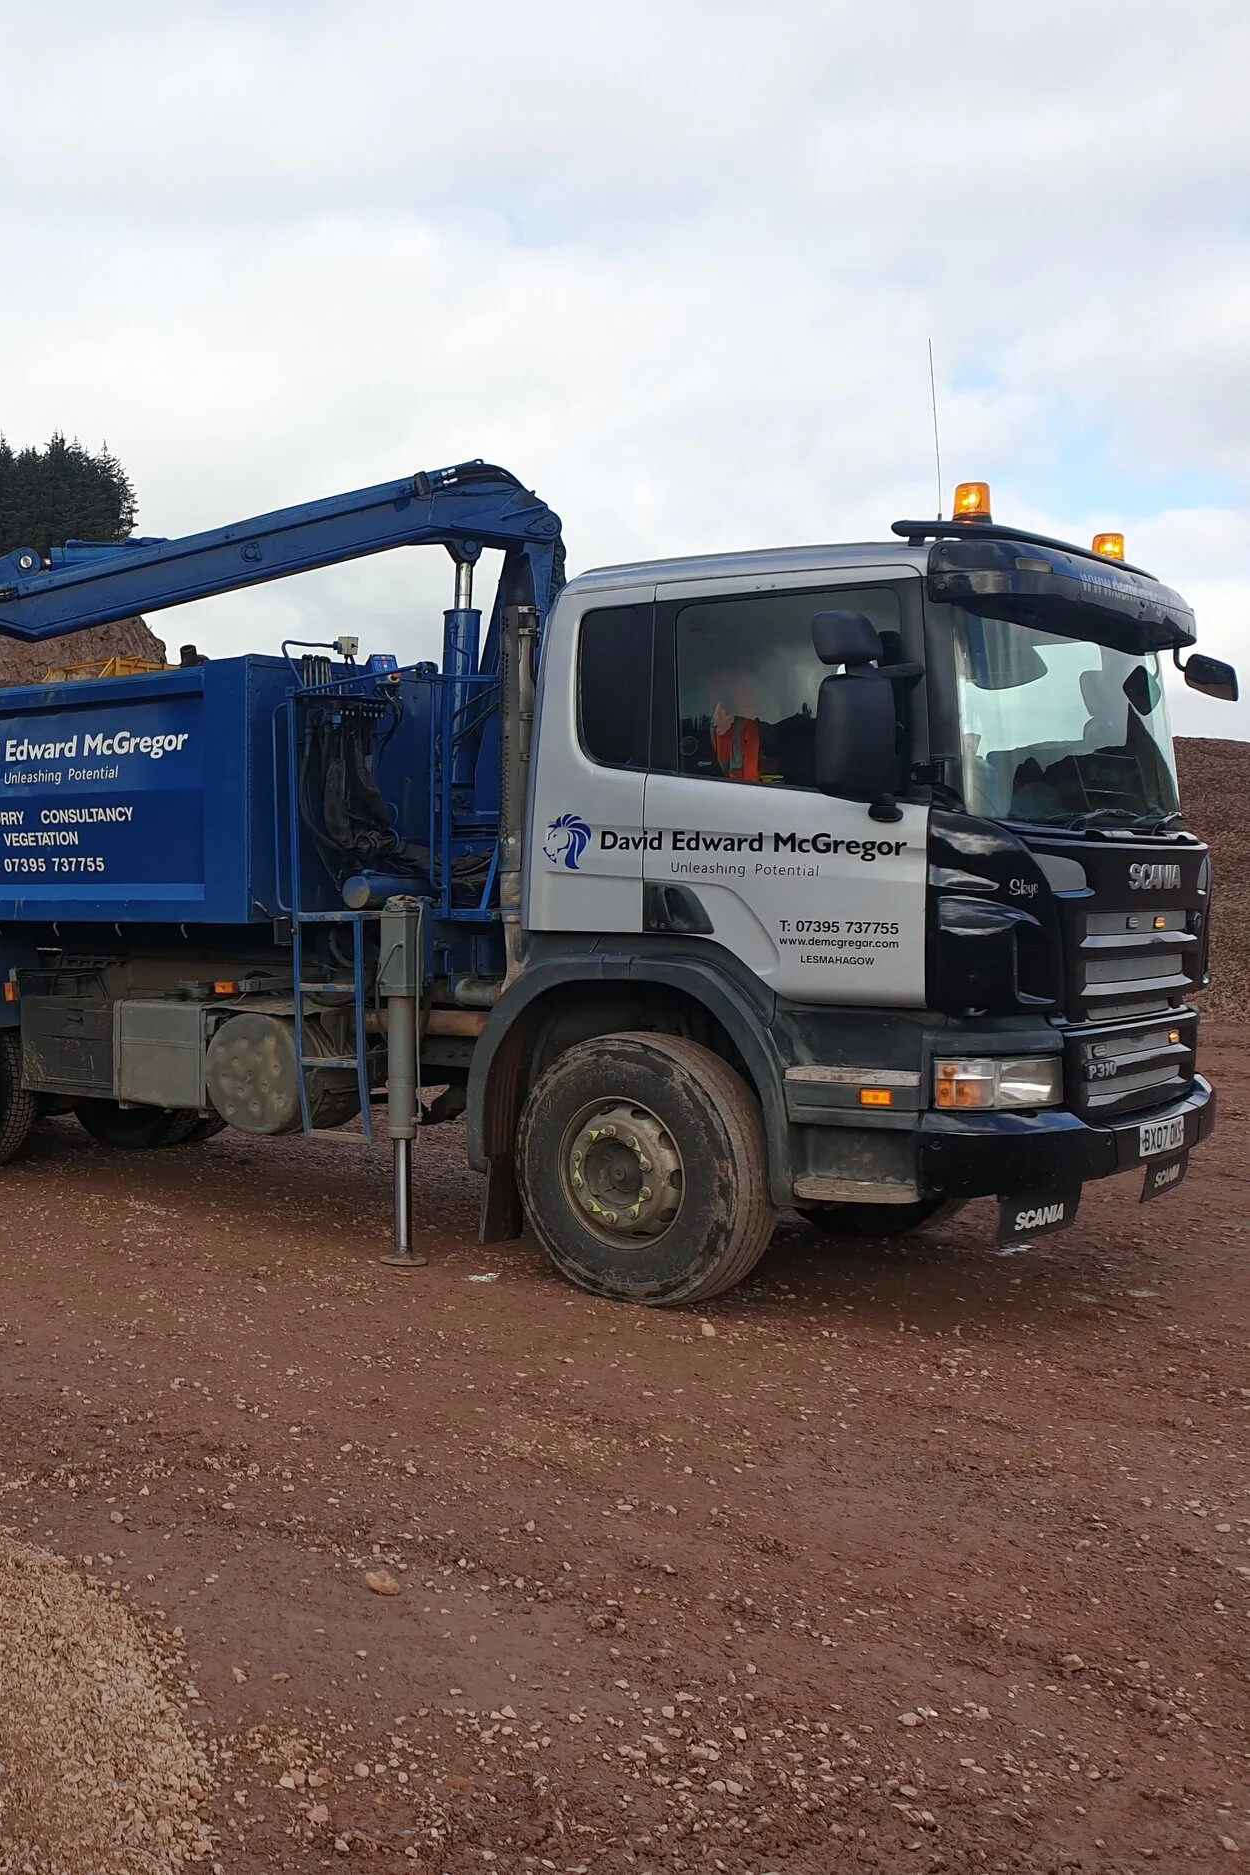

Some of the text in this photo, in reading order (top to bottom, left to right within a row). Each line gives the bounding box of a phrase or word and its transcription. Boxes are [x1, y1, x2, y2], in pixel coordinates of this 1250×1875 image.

[5, 735, 77, 762] Edward
[83, 730, 188, 759] McGregor
[3, 765, 119, 785] Unleashing Potential
[40, 806, 134, 825] CONSULTANCY
[3, 831, 79, 847] VEGETATION
[600, 830, 908, 862] David Edward McGregor
[4, 858, 46, 873] 07395
[51, 857, 105, 872] 737755
[670, 862, 821, 878] Unleashing Potential
[1129, 863, 1182, 890] SCANIA
[1009, 878, 1039, 899] Skye
[779, 919, 900, 935] T: 07395 737755
[779, 936, 900, 950] www.demcgregor.com
[800, 955, 875, 966] LESMAHAGOW
[1088, 1061, 1117, 1080] P310
[1154, 1163, 1180, 1188] SCANIA
[1014, 1202, 1064, 1231] SCANIA
